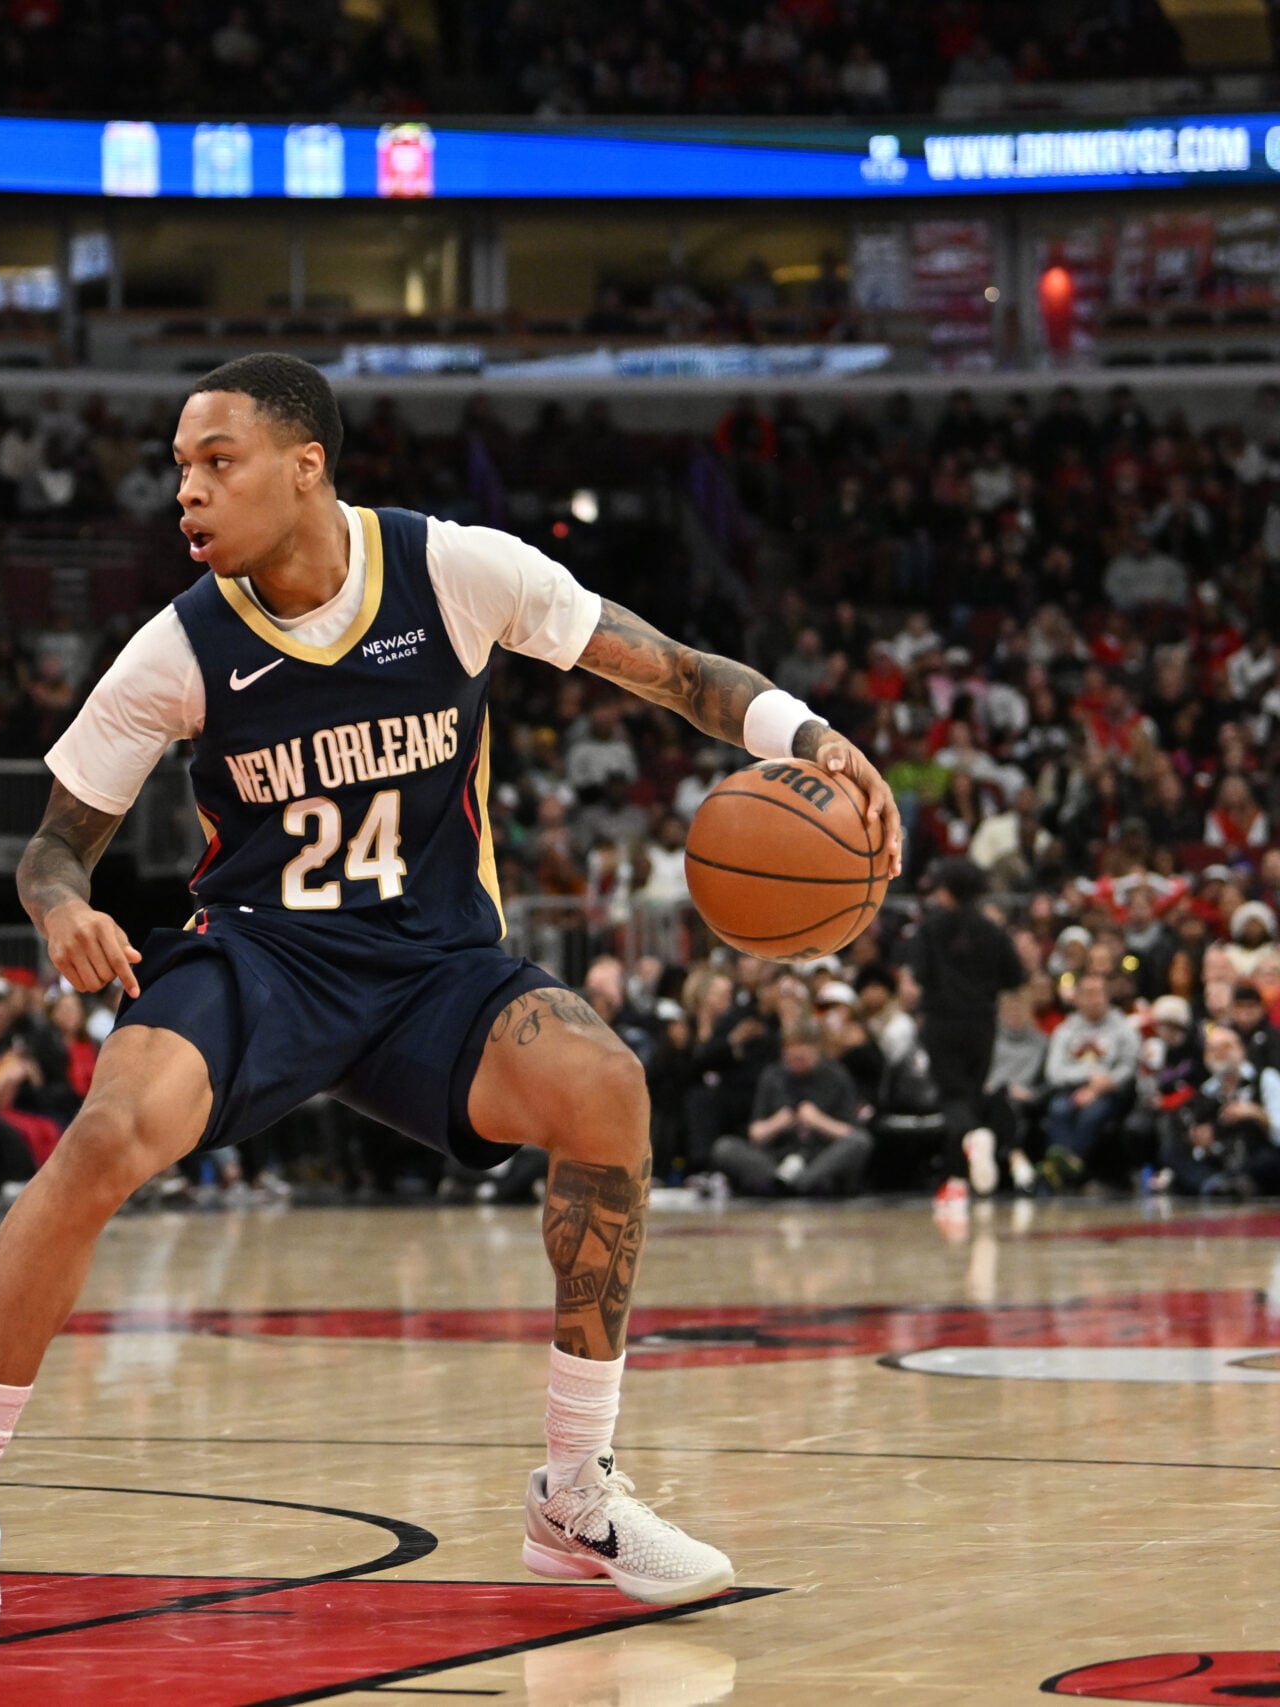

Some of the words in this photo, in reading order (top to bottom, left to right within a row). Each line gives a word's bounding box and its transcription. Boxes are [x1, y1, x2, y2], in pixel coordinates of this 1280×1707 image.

[362, 628, 426, 658] NEWAGE
[377, 647, 418, 665] GARAGE
[224, 737, 306, 804] NEW
[312, 707, 459, 789] ORLEANS
[281, 788, 408, 911] 24
